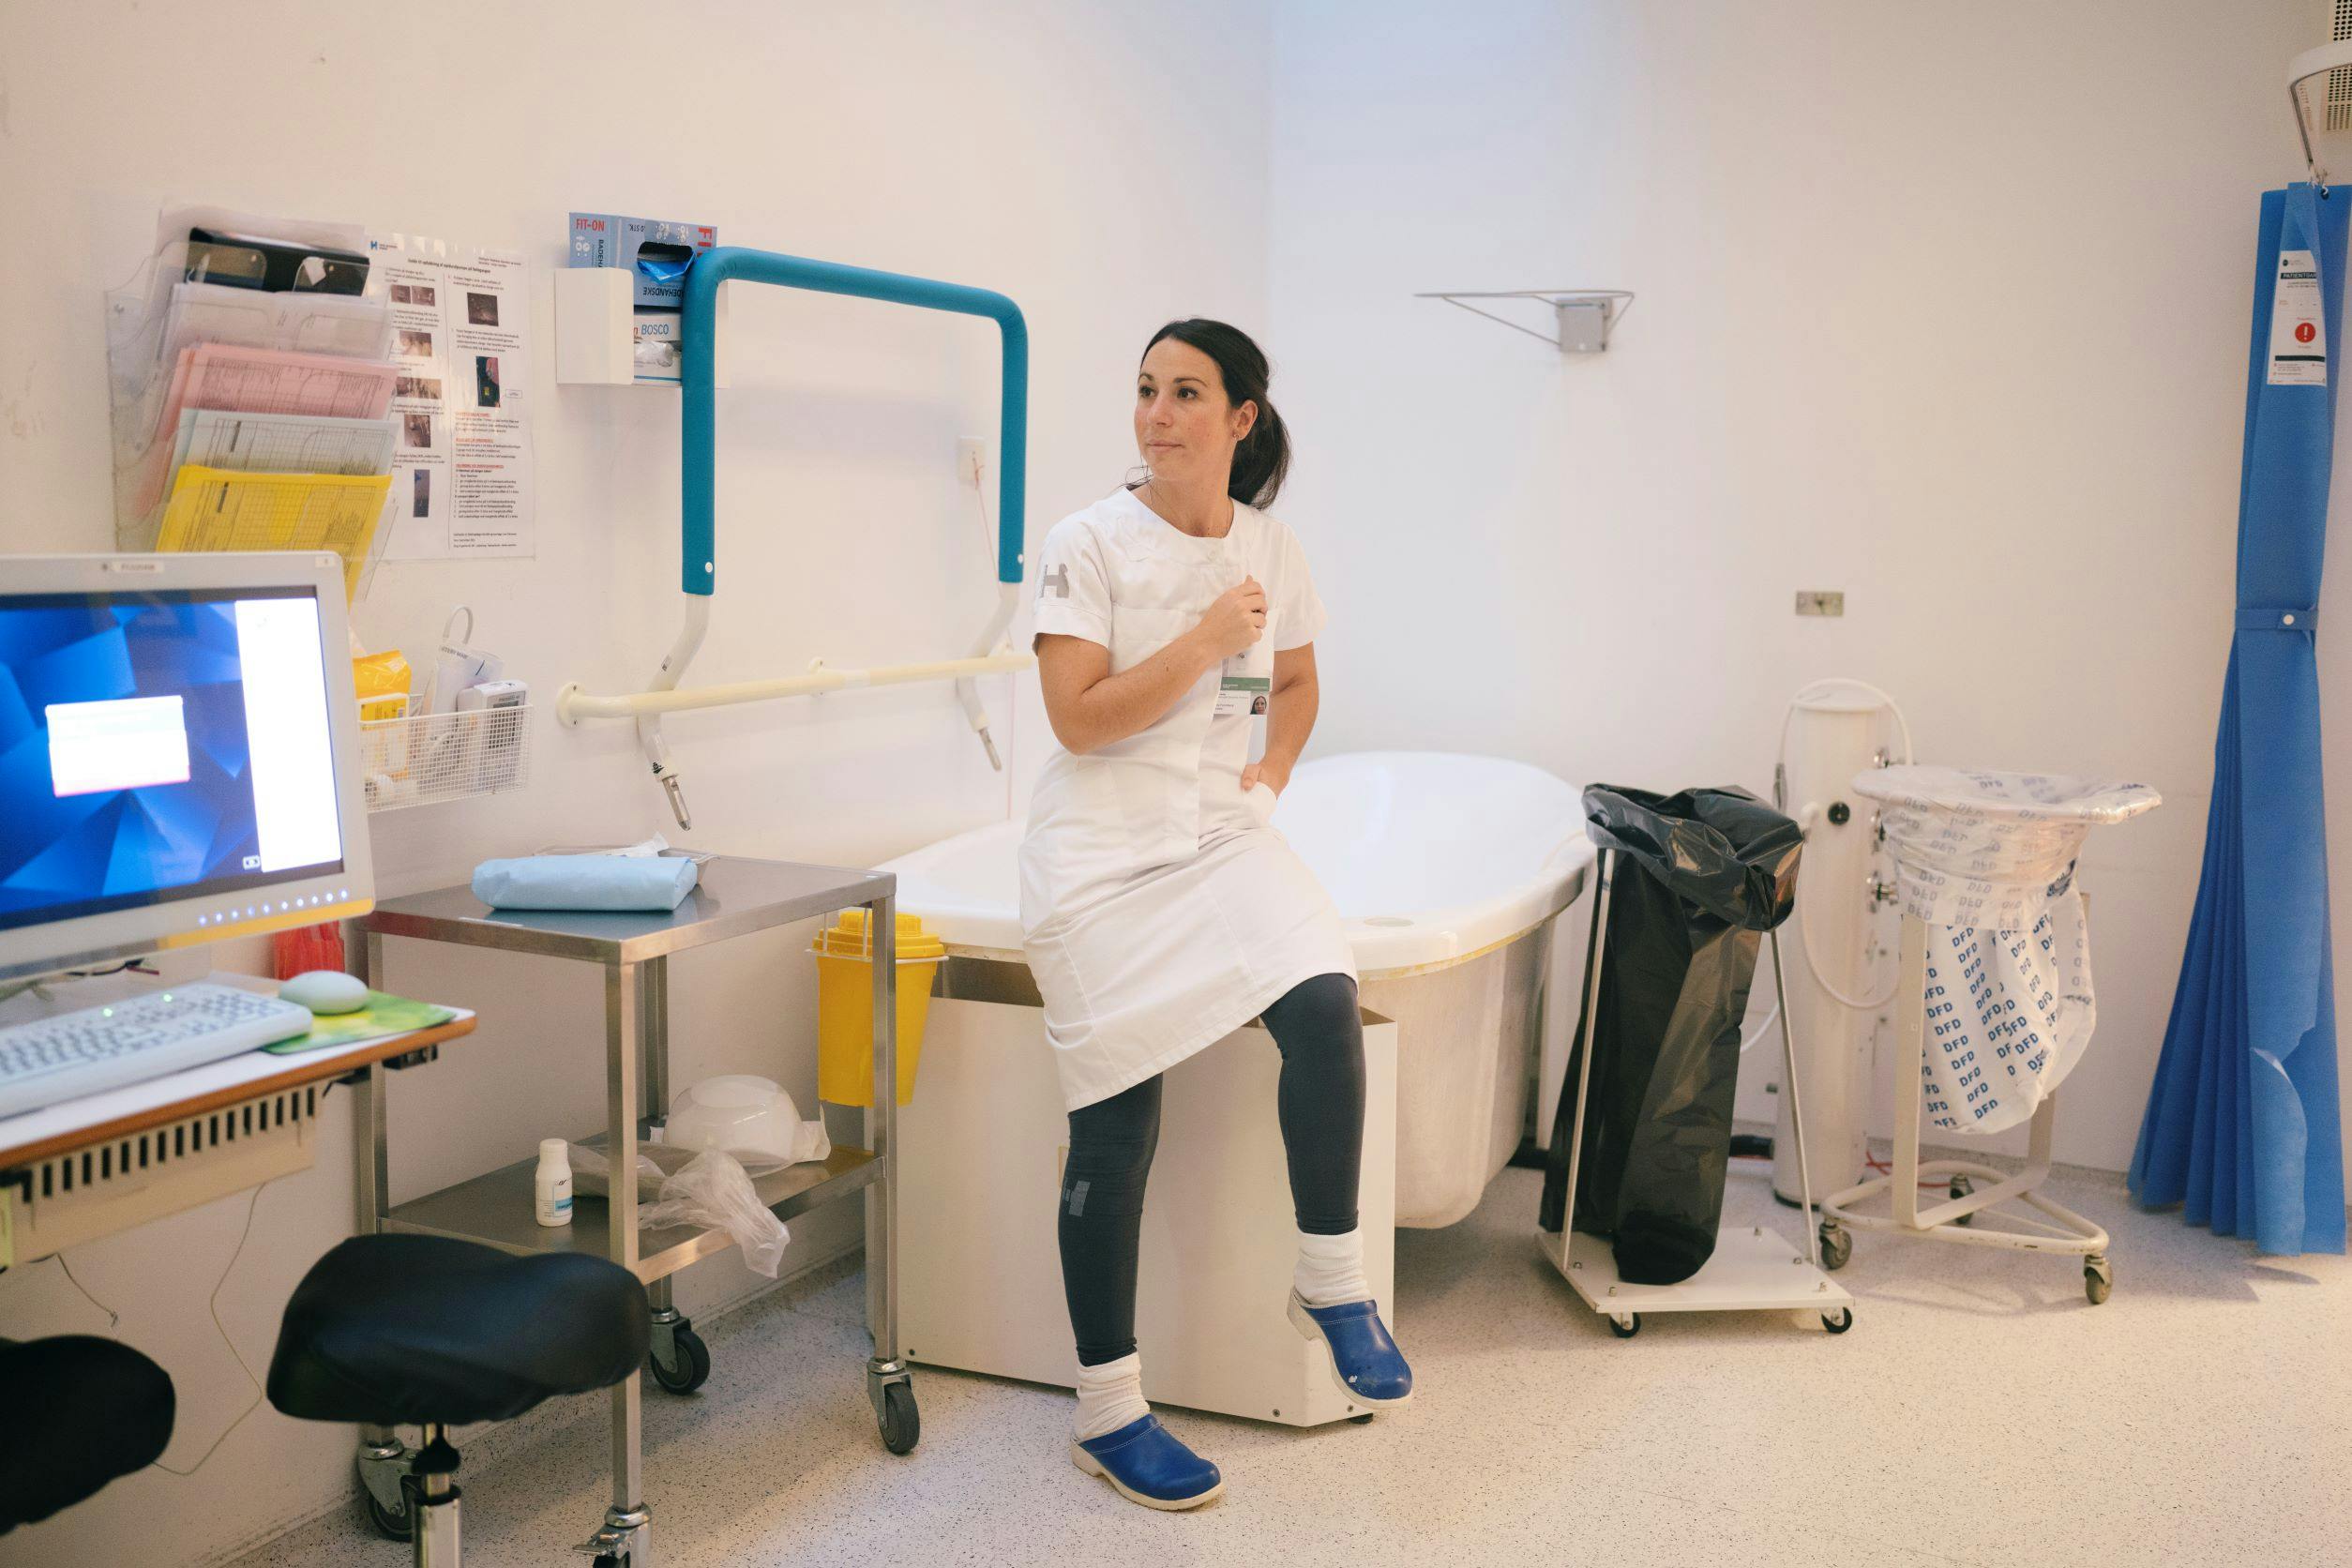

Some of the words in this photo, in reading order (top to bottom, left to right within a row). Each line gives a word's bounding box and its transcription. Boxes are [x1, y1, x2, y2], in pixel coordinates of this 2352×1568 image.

[576, 219, 605, 232] FIT-ON
[641, 324, 670, 336] BOSCO
[1952, 927, 1974, 947] DFD
[2041, 934, 2054, 950] DF
[1958, 942, 1978, 963] DFD
[2011, 939, 2027, 957] DFD
[1964, 957, 1982, 978] DFD
[1969, 972, 1985, 994] DFD
[2029, 974, 2042, 992] DFD
[1976, 988, 1992, 1009] DFD
[2037, 991, 2053, 1010] DFD
[1926, 1003, 1952, 1018] DFD
[1982, 1003, 2001, 1025] DFD
[2045, 1012, 2057, 1027] DF
[1935, 1018, 1961, 1035] DFD
[1943, 1035, 1968, 1052] DFD
[1997, 1043, 2012, 1058] DF
[2014, 1033, 2039, 1054] DFD
[1951, 1051, 1975, 1070] DFD
[1959, 1066, 1981, 1087] DFD
[1968, 1082, 1988, 1103] DFD
[1927, 1101, 1948, 1112] DFD
[1974, 1099, 1998, 1120] DFD
